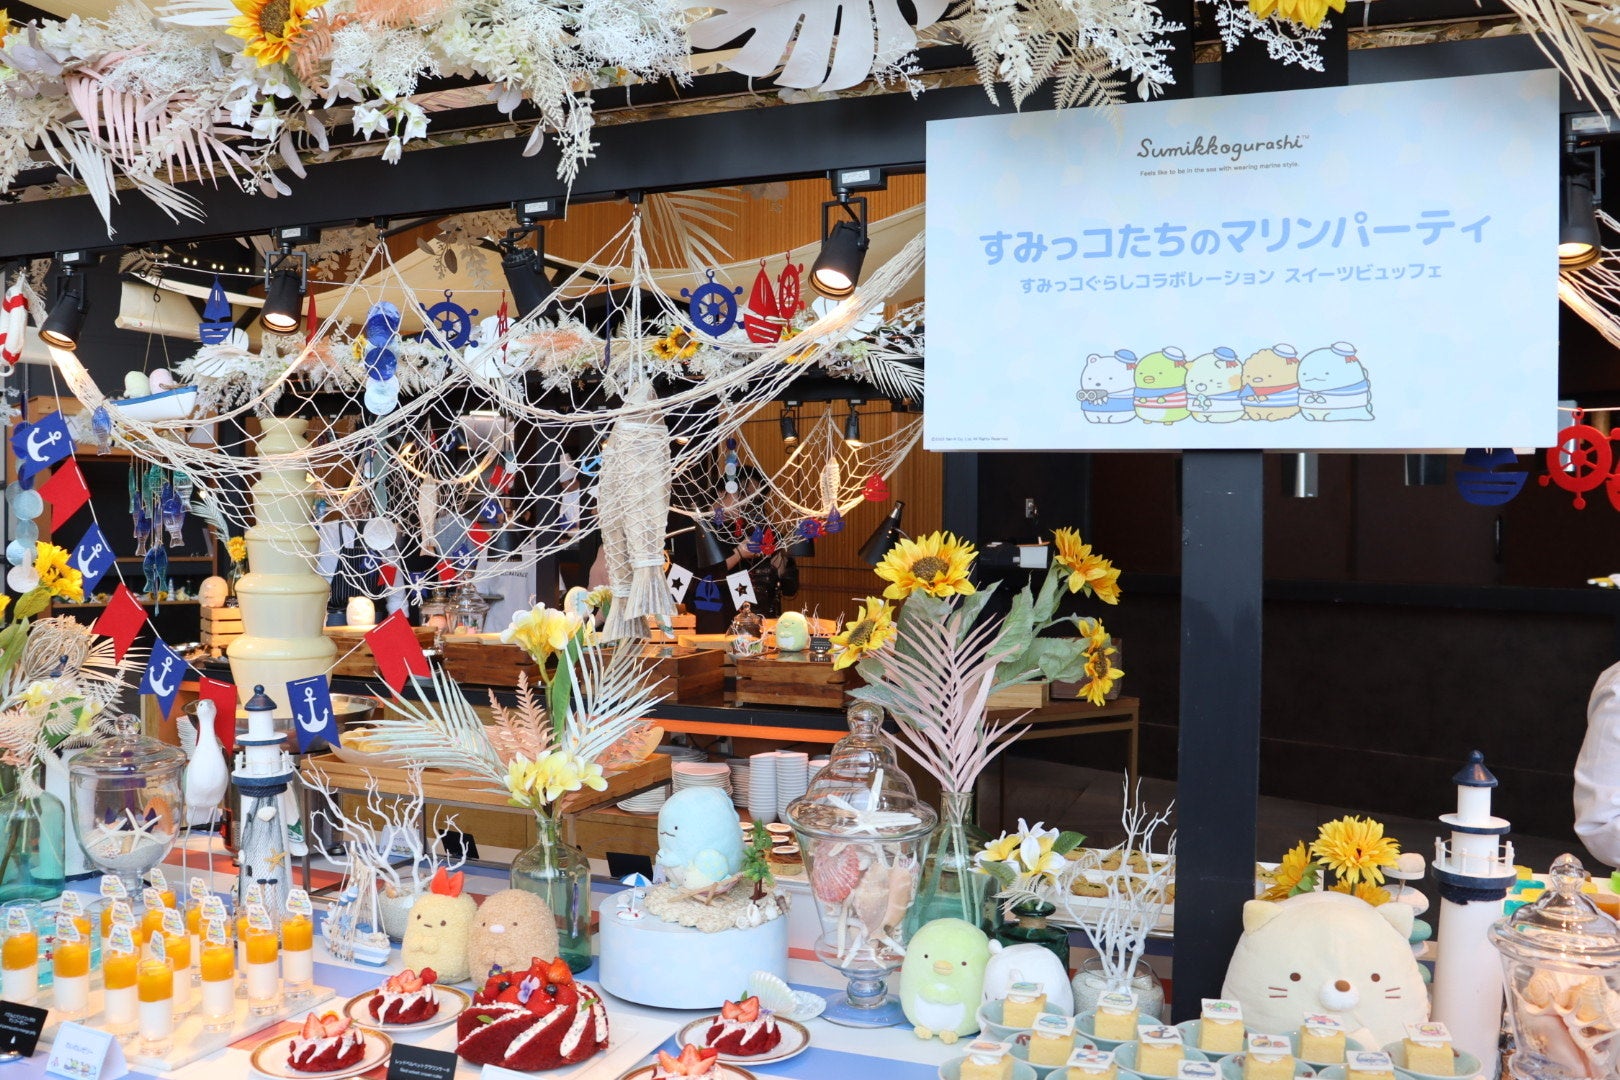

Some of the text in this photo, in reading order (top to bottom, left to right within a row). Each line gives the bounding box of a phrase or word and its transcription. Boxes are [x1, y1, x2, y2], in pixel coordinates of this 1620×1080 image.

[1140, 169, 1157, 177] Feels
[1158, 168, 1168, 176] like
[1177, 167, 1186, 175] be
[1259, 162, 1281, 170] marine
[979, 210, 1492, 266] すみっコたちのマリンパーティ
[1019, 262, 1442, 294] すみっコぐらしコラボレーション スイーツビュッフェ
